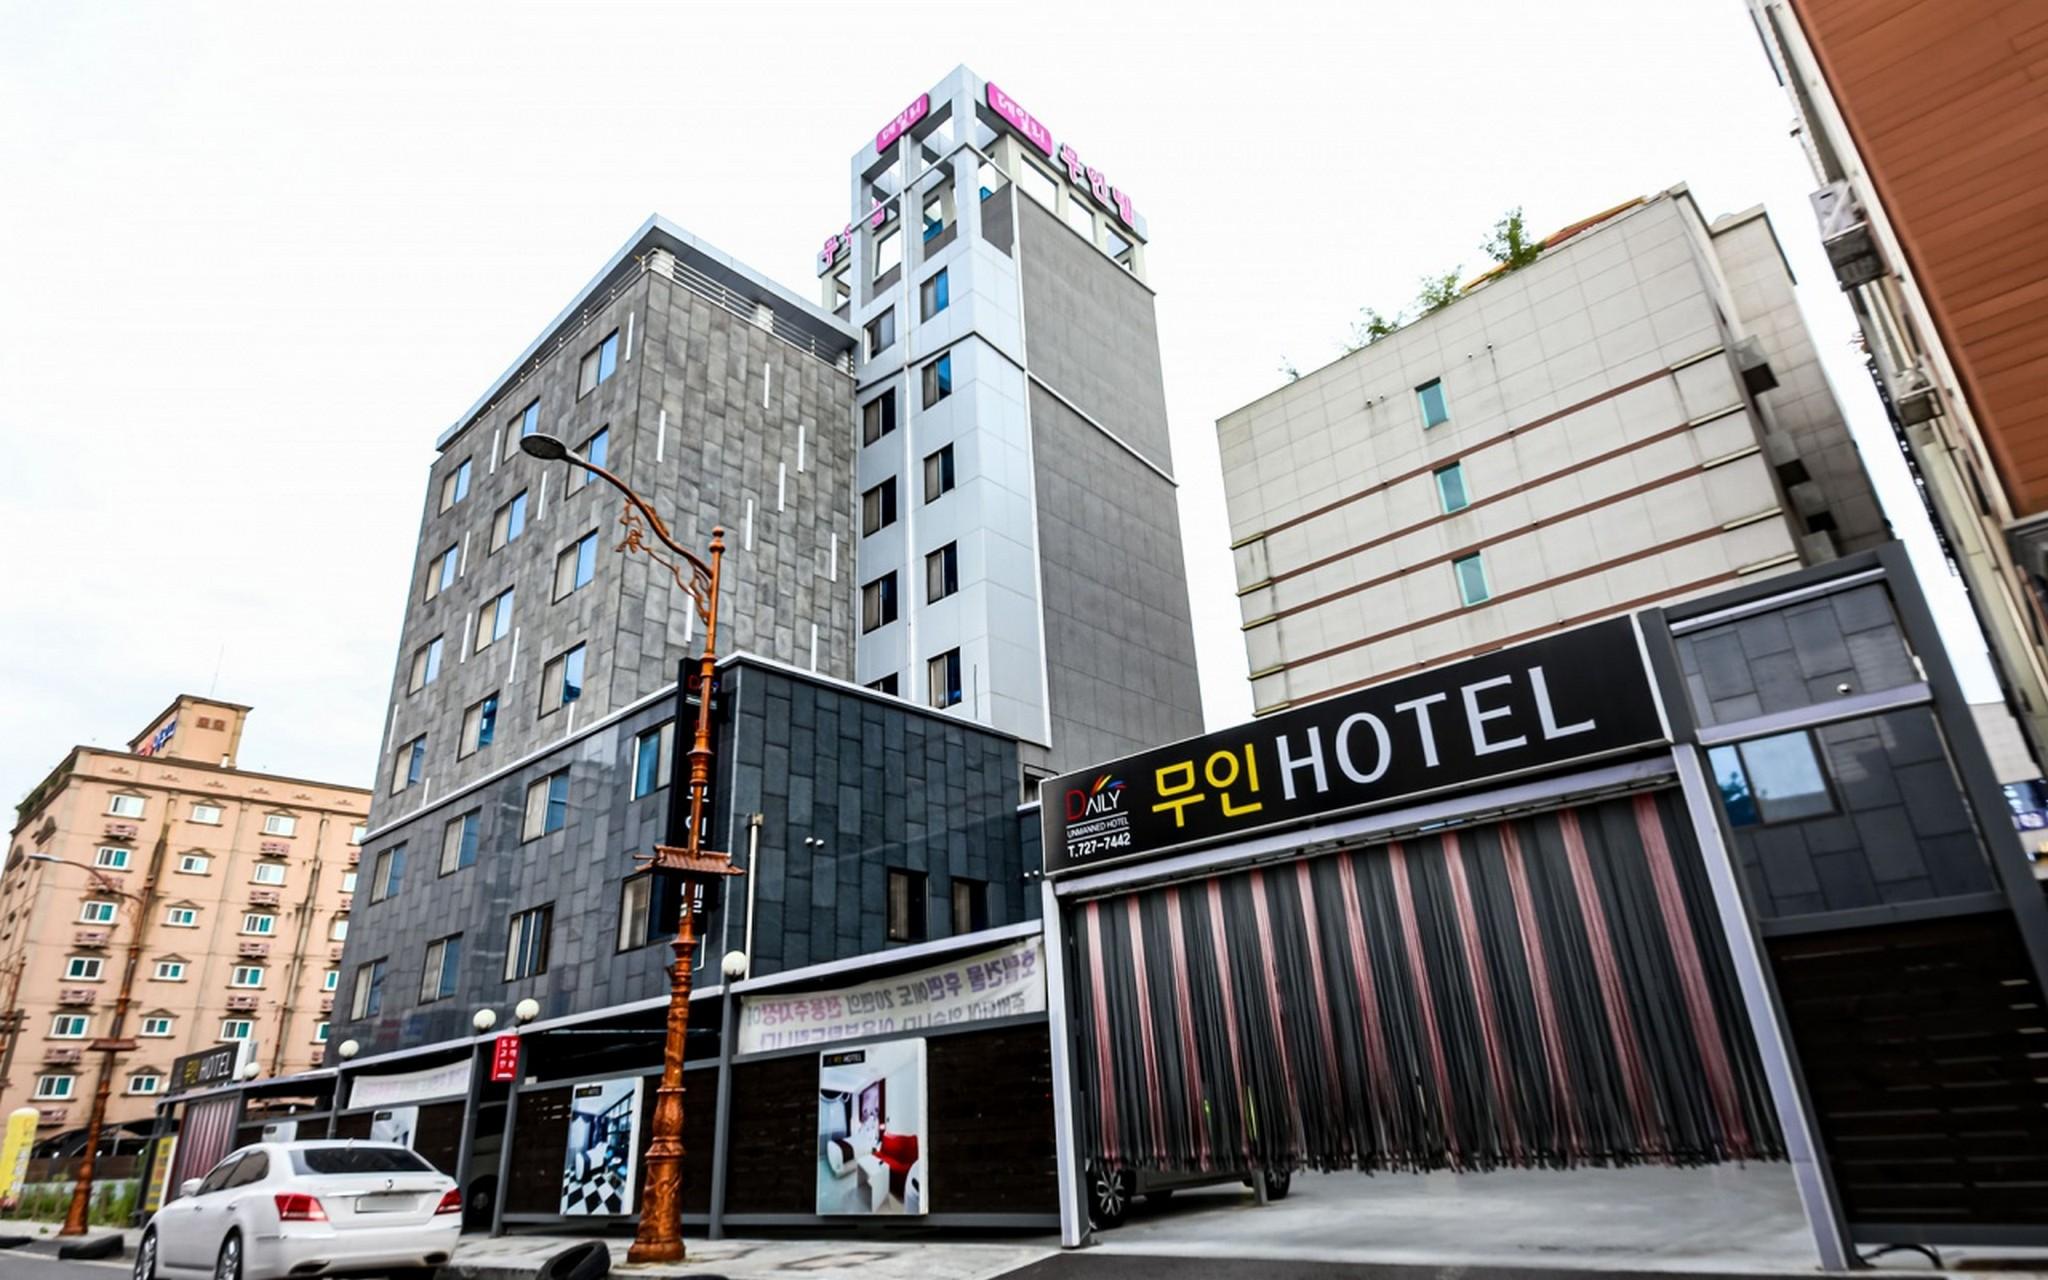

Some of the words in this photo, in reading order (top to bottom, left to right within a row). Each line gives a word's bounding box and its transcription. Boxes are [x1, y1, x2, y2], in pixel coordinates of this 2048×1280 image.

[1152, 743, 1263, 827] 무인
[1275, 665, 1596, 800] HOTEL
[1064, 788, 1121, 820] DAILY
[1066, 822, 1105, 839] UNMANNED
[1106, 816, 1129, 830] HOTEL
[1067, 832, 1131, 858] T.727-7442
[199, 1051, 231, 1080] HOTEL
